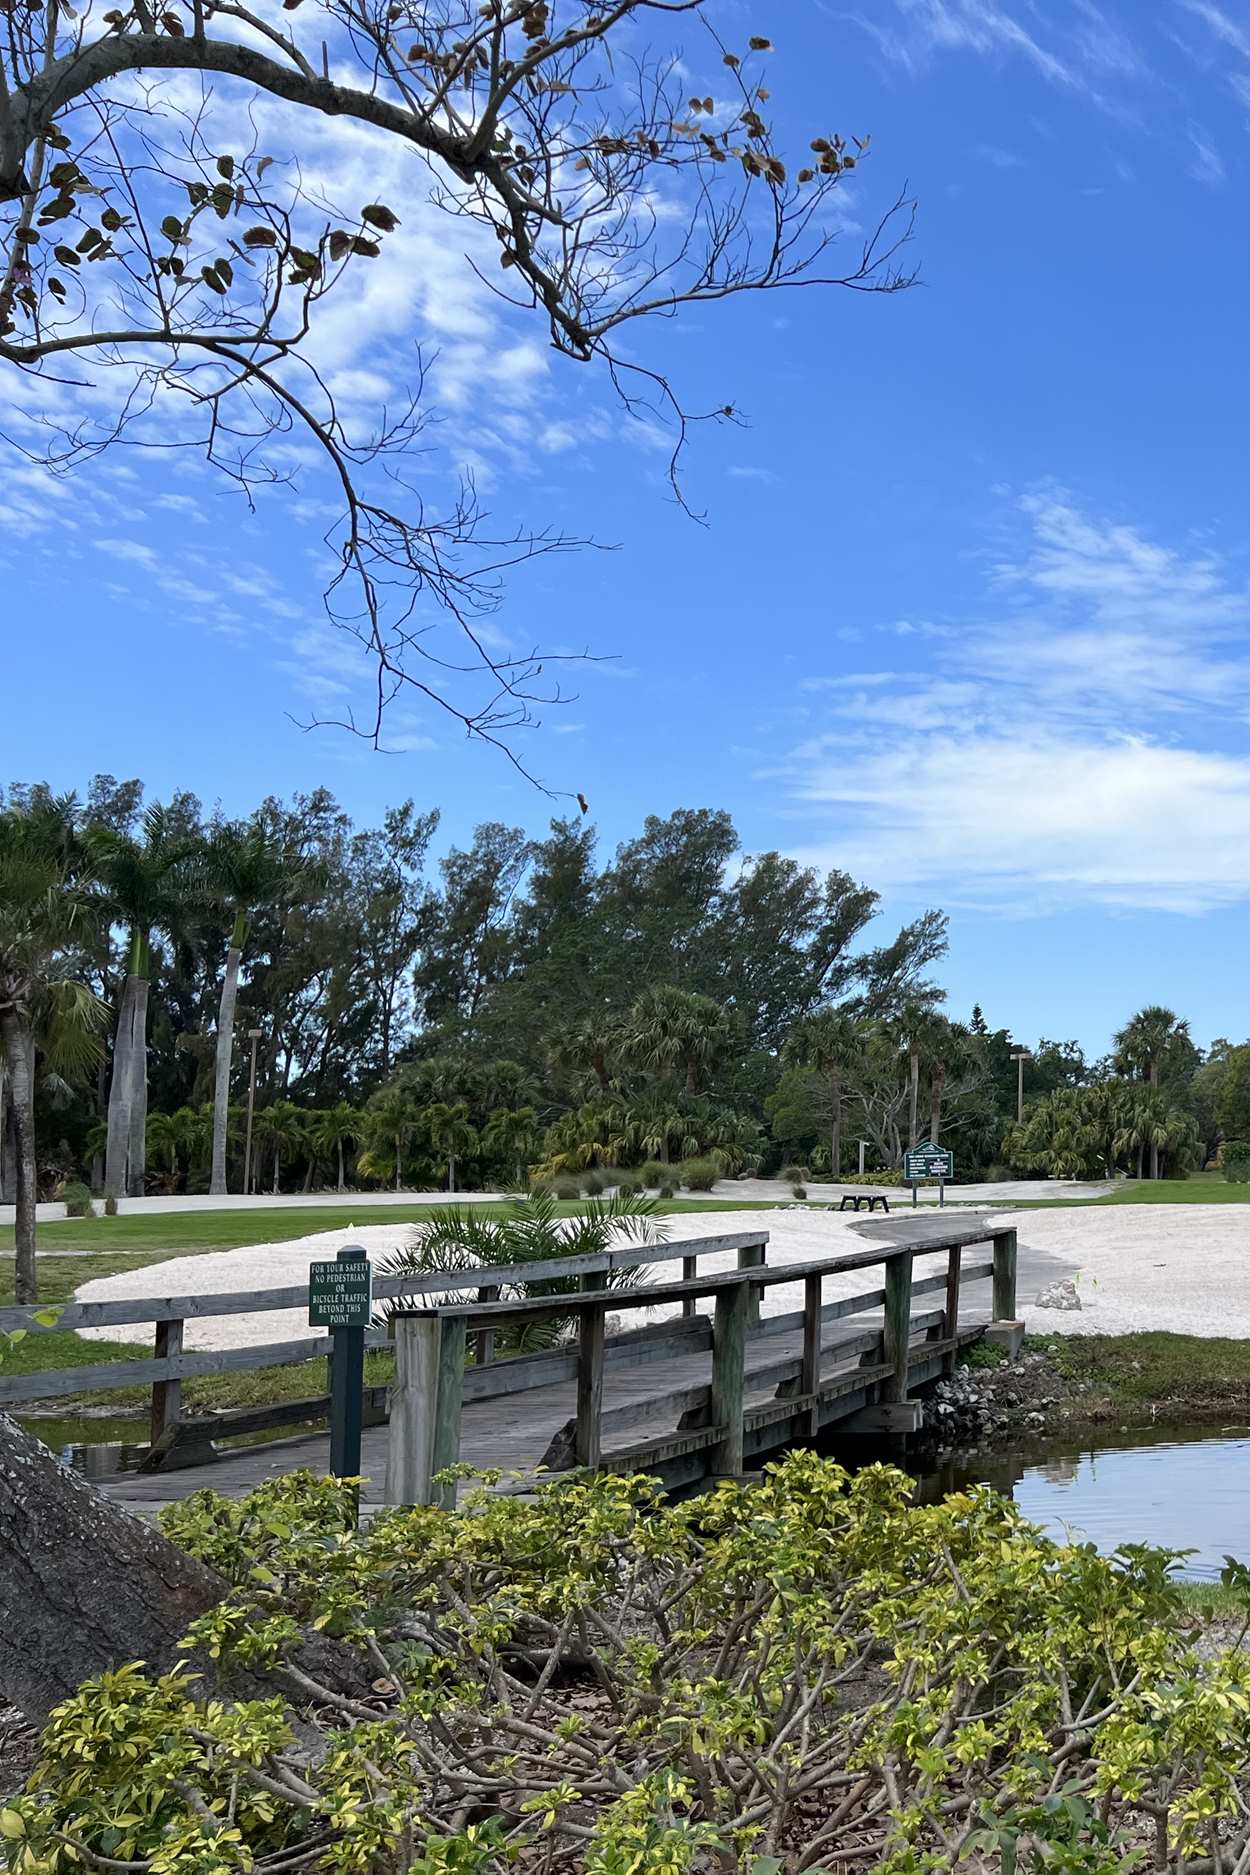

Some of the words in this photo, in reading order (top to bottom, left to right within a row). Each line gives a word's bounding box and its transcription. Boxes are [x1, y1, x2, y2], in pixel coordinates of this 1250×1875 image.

[312, 1264, 324, 1273] FOR
[326, 1264, 344, 1273] YOUR
[346, 1263, 368, 1271] SAFETY
[326, 1273, 365, 1282] PEDESTRIAN
[336, 1284, 345, 1292] OR
[312, 1294, 339, 1303] BICYCLE
[341, 1294, 367, 1302] TRAFFIC
[319, 1304, 344, 1313] BEYOND
[347, 1304, 360, 1312] THIS
[330, 1315, 349, 1323] POINT
